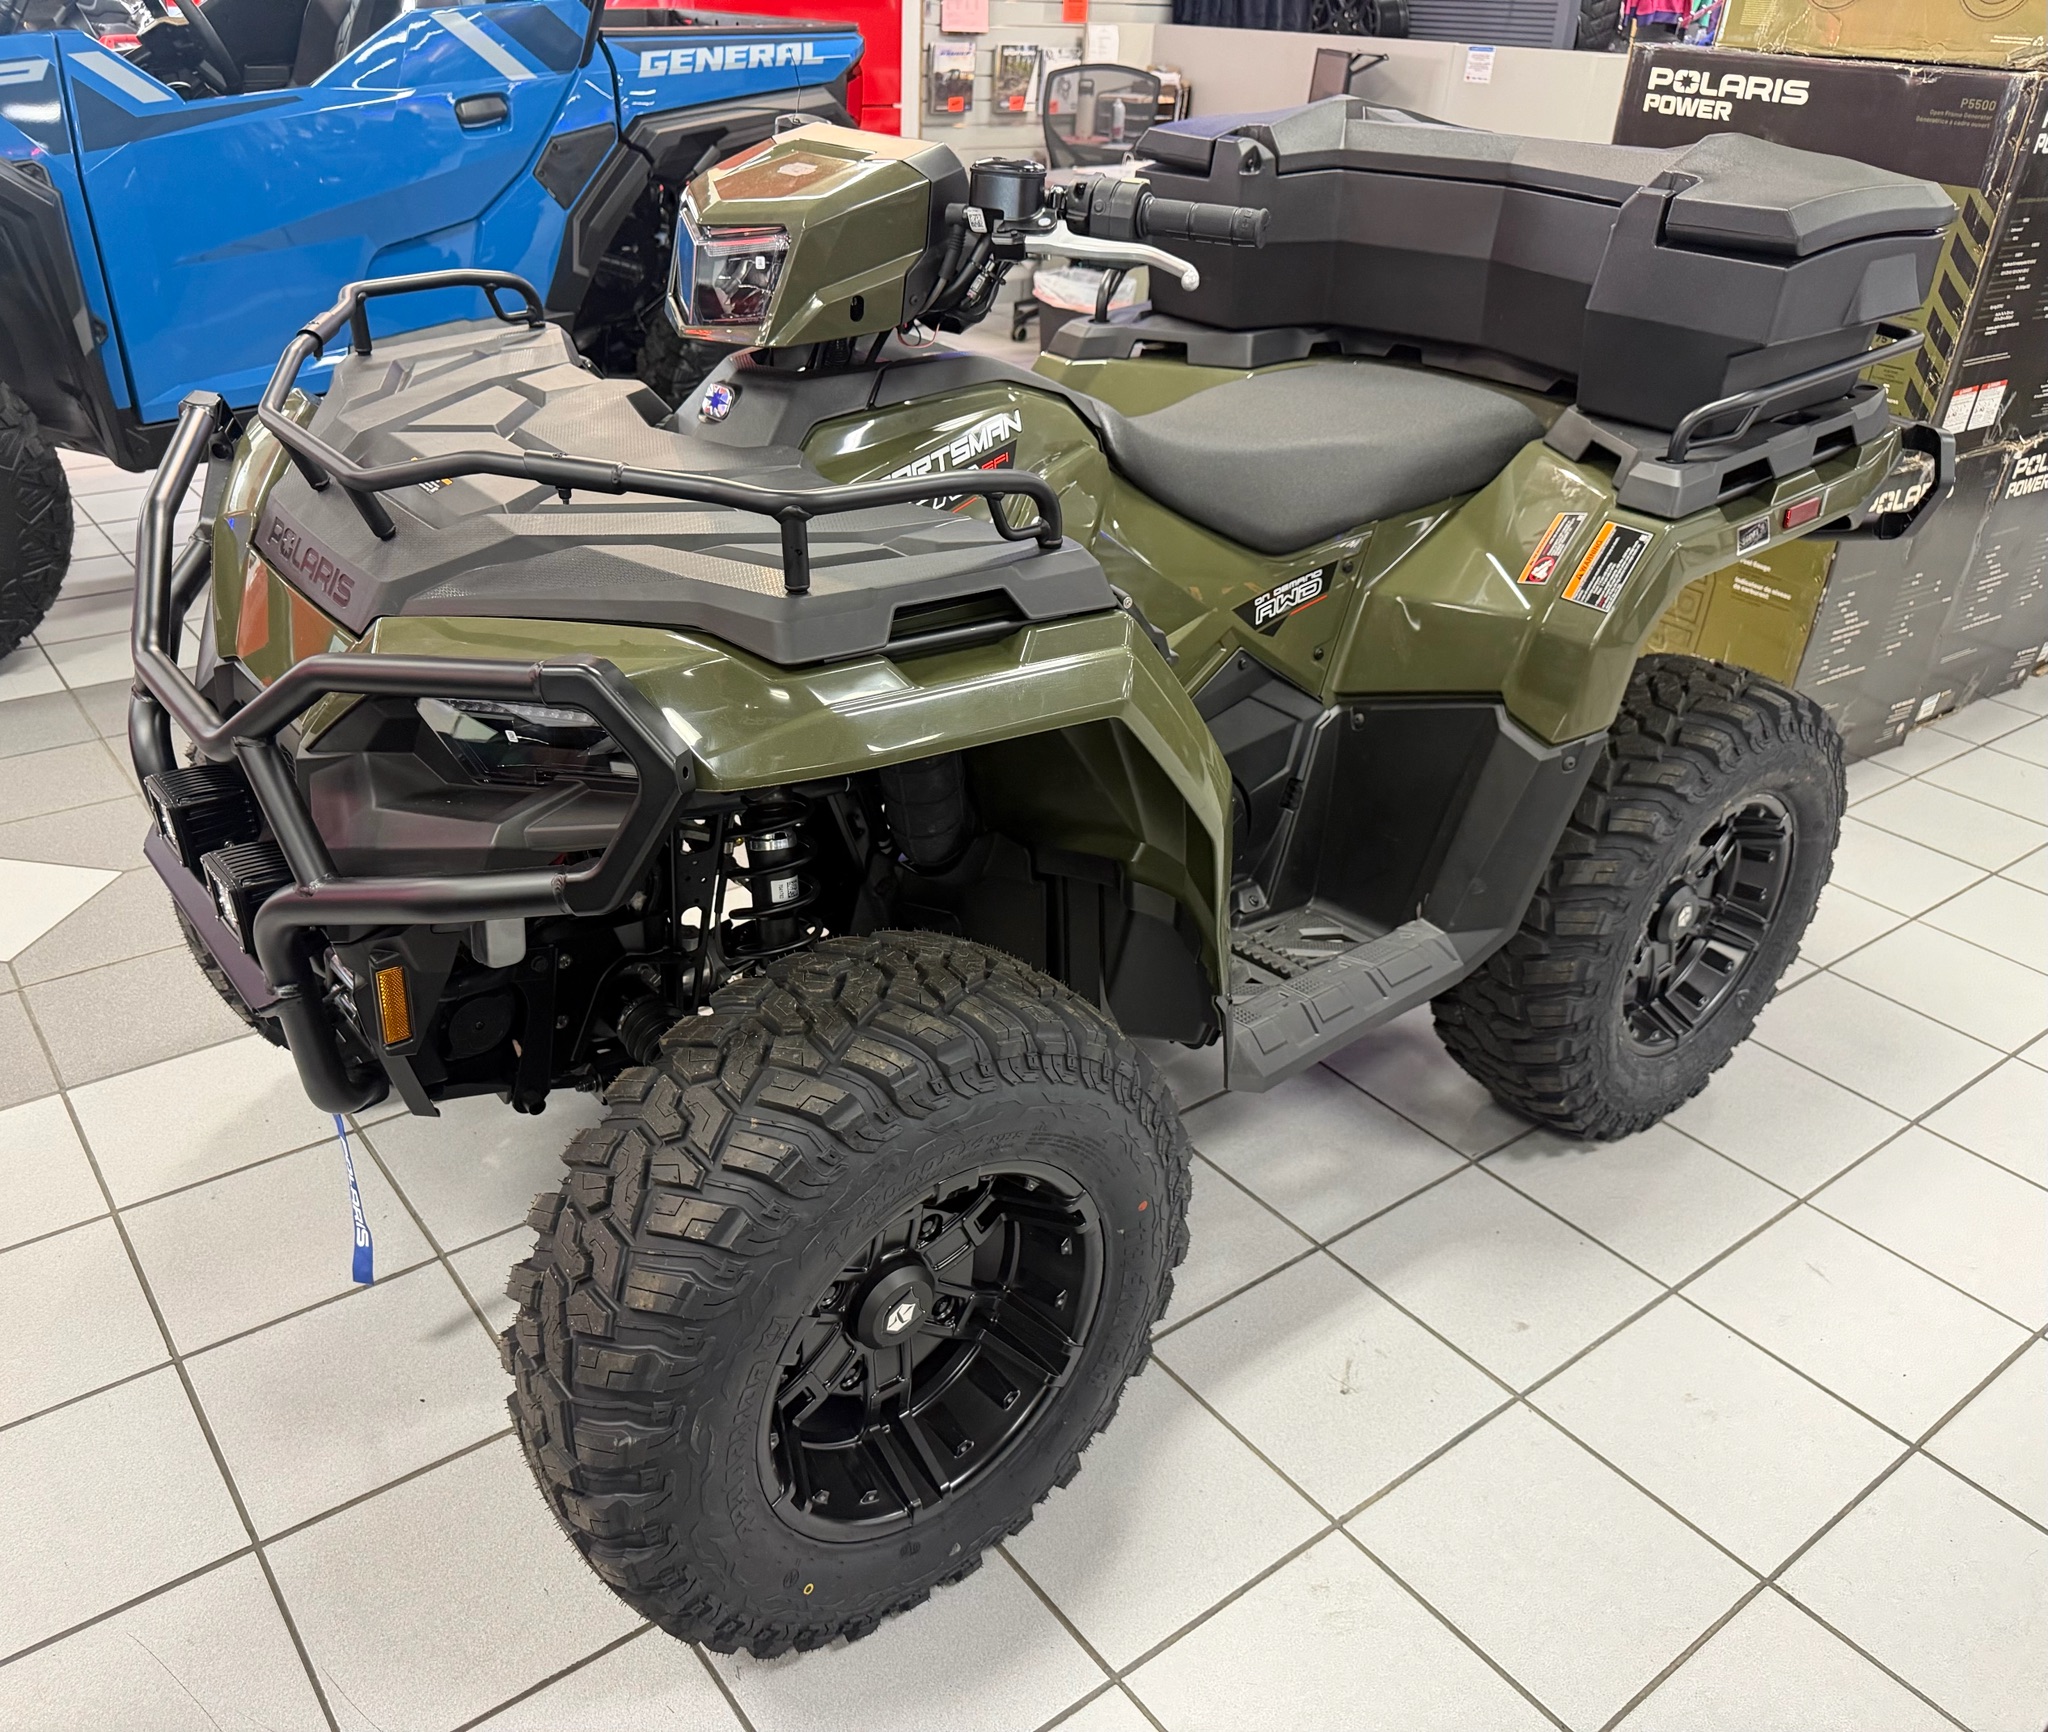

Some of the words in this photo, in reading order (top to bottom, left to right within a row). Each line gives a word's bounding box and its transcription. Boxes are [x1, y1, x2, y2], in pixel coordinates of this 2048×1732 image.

[638, 42, 825, 78] GENERAL
[1647, 66, 1810, 106] POLARIS
[1960, 98, 1997, 112] P5500
[1643, 92, 1733, 122] POWER
[266, 516, 356, 609] POLARIS
[1255, 577, 1323, 625] AWD
